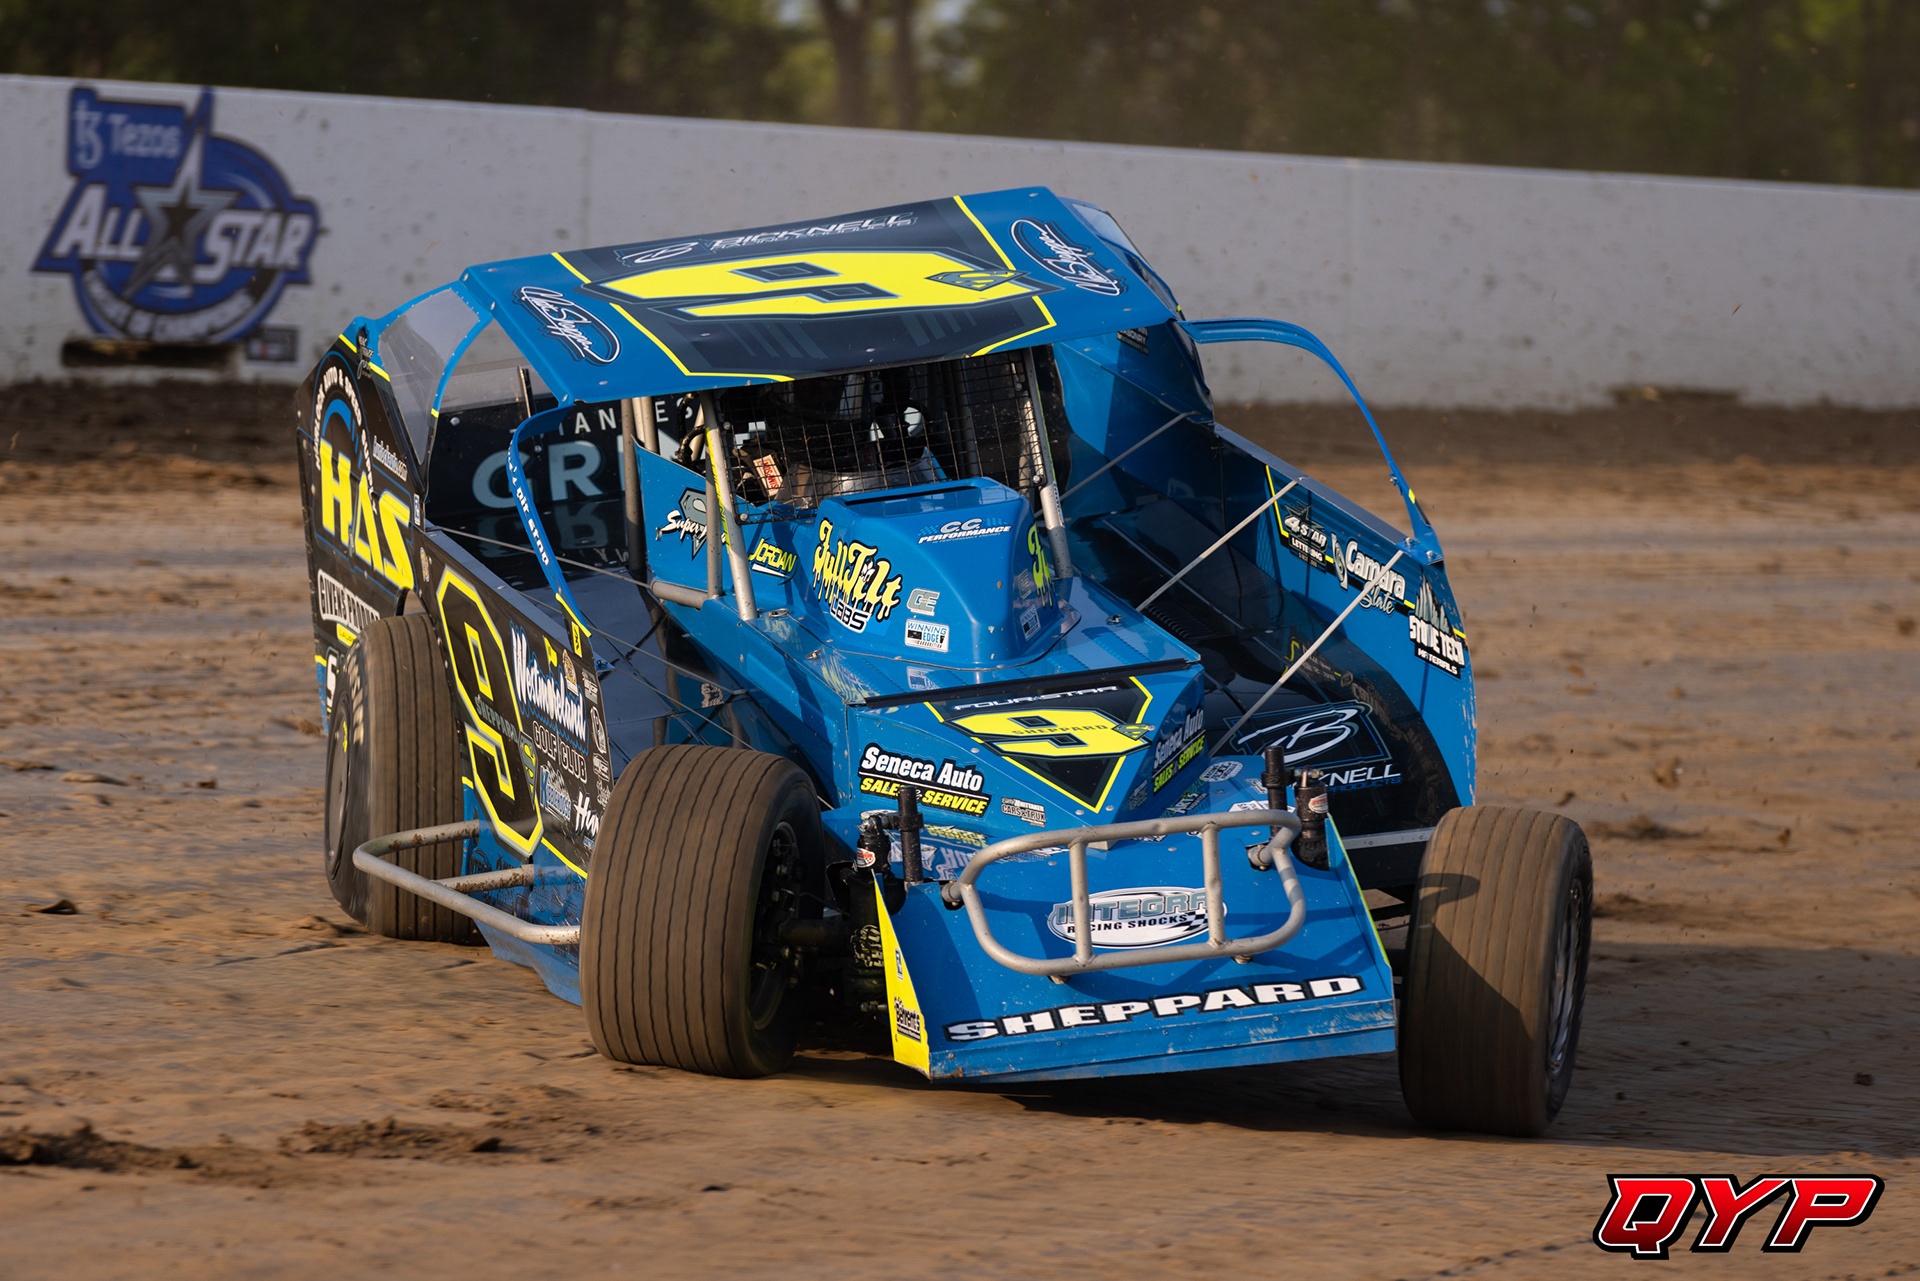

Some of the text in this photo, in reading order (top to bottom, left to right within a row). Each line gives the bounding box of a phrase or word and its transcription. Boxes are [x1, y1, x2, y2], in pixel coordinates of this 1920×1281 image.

[52, 183, 314, 285] ALL STAR
[320, 437, 414, 591] HAS
[918, 525, 1012, 544] PERFORMANCE
[748, 537, 797, 573] JORDAN
[907, 621, 948, 636] WINNING
[922, 632, 940, 644] EDGE
[1011, 724, 1108, 736] SHEPPARD
[1153, 707, 1205, 770] Seneca Auto
[532, 720, 558, 761] GOLF
[560, 741, 588, 784] CLUB
[861, 746, 984, 792] Seneca Auto
[1153, 762, 1174, 793] SALES
[1178, 734, 1206, 770] SERVICE
[921, 789, 988, 815] SERVICE
[1067, 914, 1189, 934] RCING SHOCKS
[948, 975, 1362, 1042] SHEPPARD
